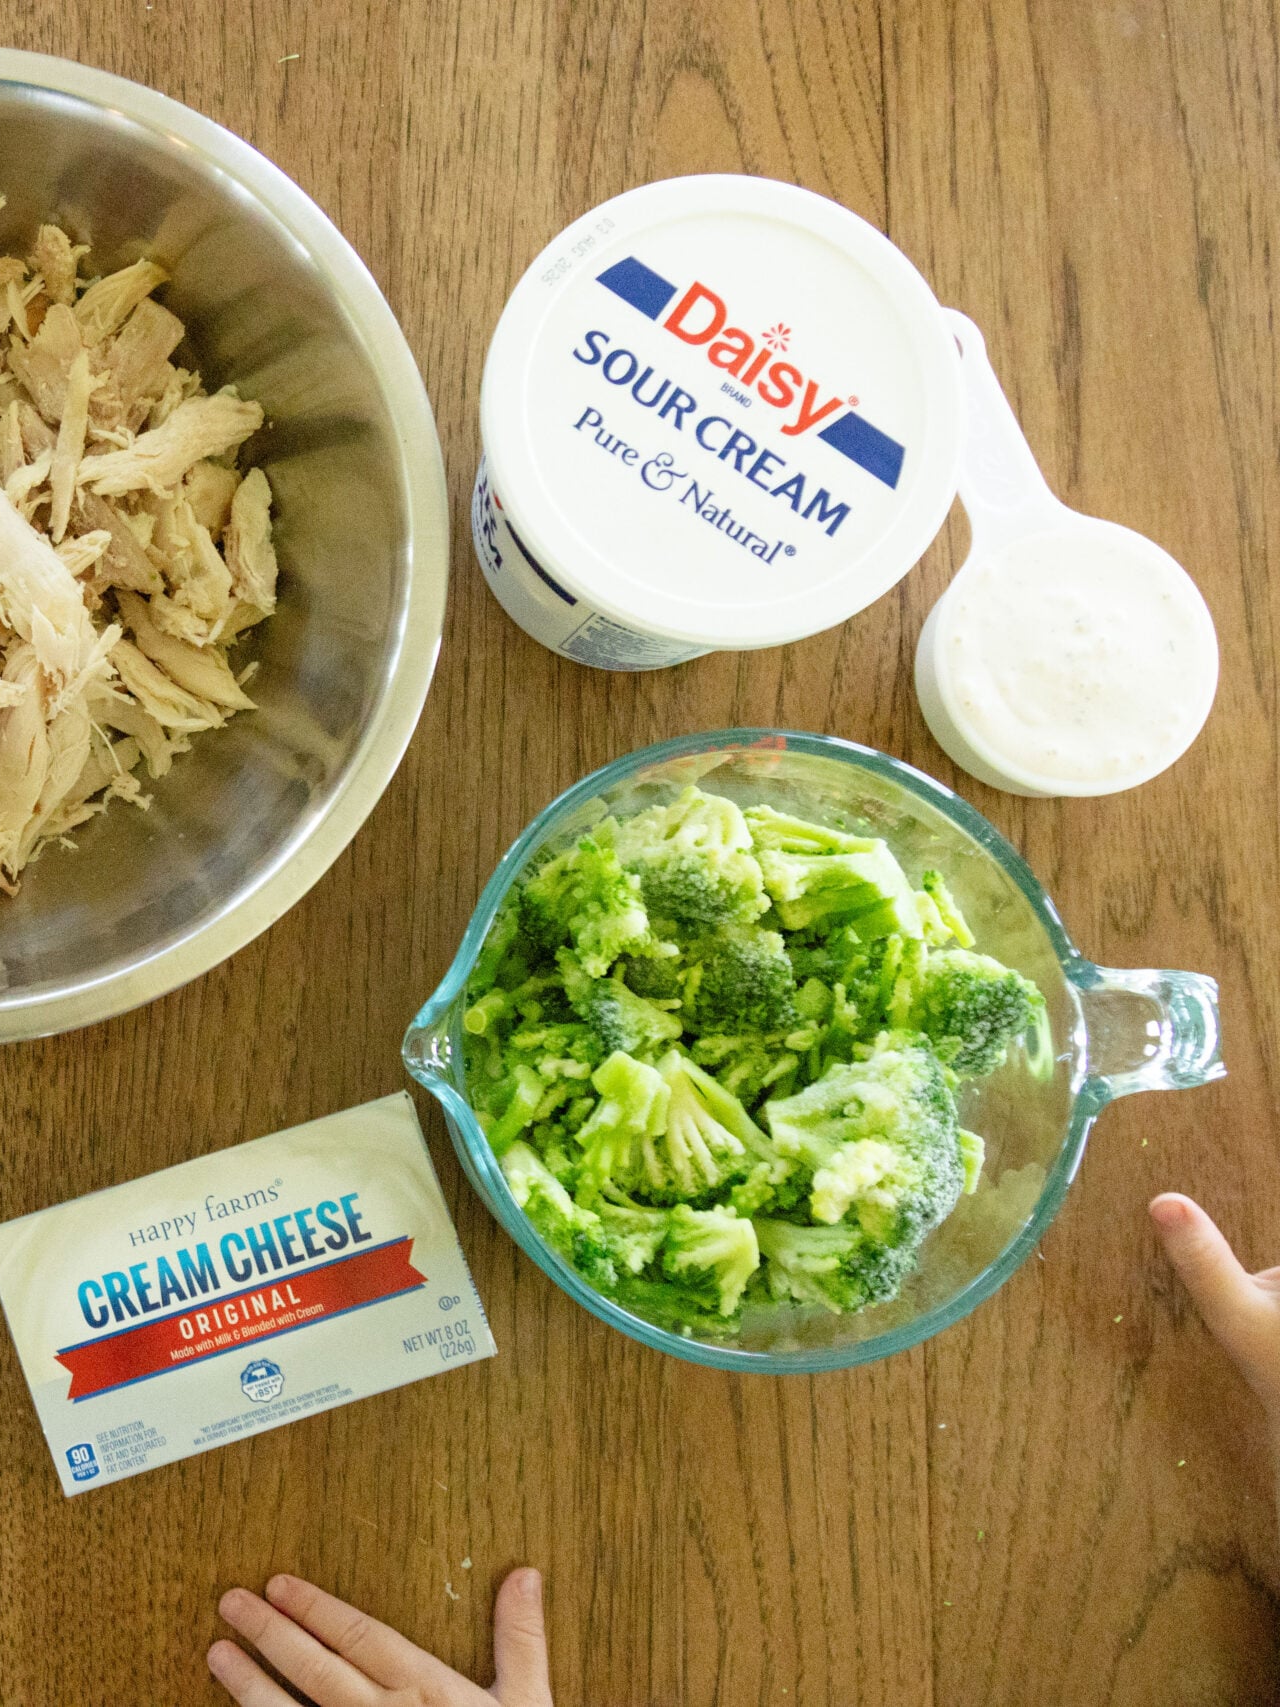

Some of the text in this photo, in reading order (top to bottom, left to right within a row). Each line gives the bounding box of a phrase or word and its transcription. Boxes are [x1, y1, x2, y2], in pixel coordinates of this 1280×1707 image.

[720, 382, 752, 408] BRAND
[572, 330, 697, 431] SOUR
[695, 416, 851, 537] CREAM
[572, 406, 639, 466] Pure
[641, 452, 688, 491] &
[77, 1192, 373, 1329] CREAM CHEESE
[179, 1284, 301, 1340] ORIGINAL
[171, 1303, 325, 1361] Made with Milk & Blended with Cream
[402, 1319, 471, 1354] NET WT 8 OZ
[439, 1335, 476, 1362] (226g)
[96, 1420, 145, 1443] SEE NUTRITION
[100, 1427, 158, 1453] INFORMATION FOR
[72, 1447, 90, 1465] 90
[103, 1436, 167, 1464] FAT AND SATURATED
[106, 1454, 148, 1475] FAT CONTENT
